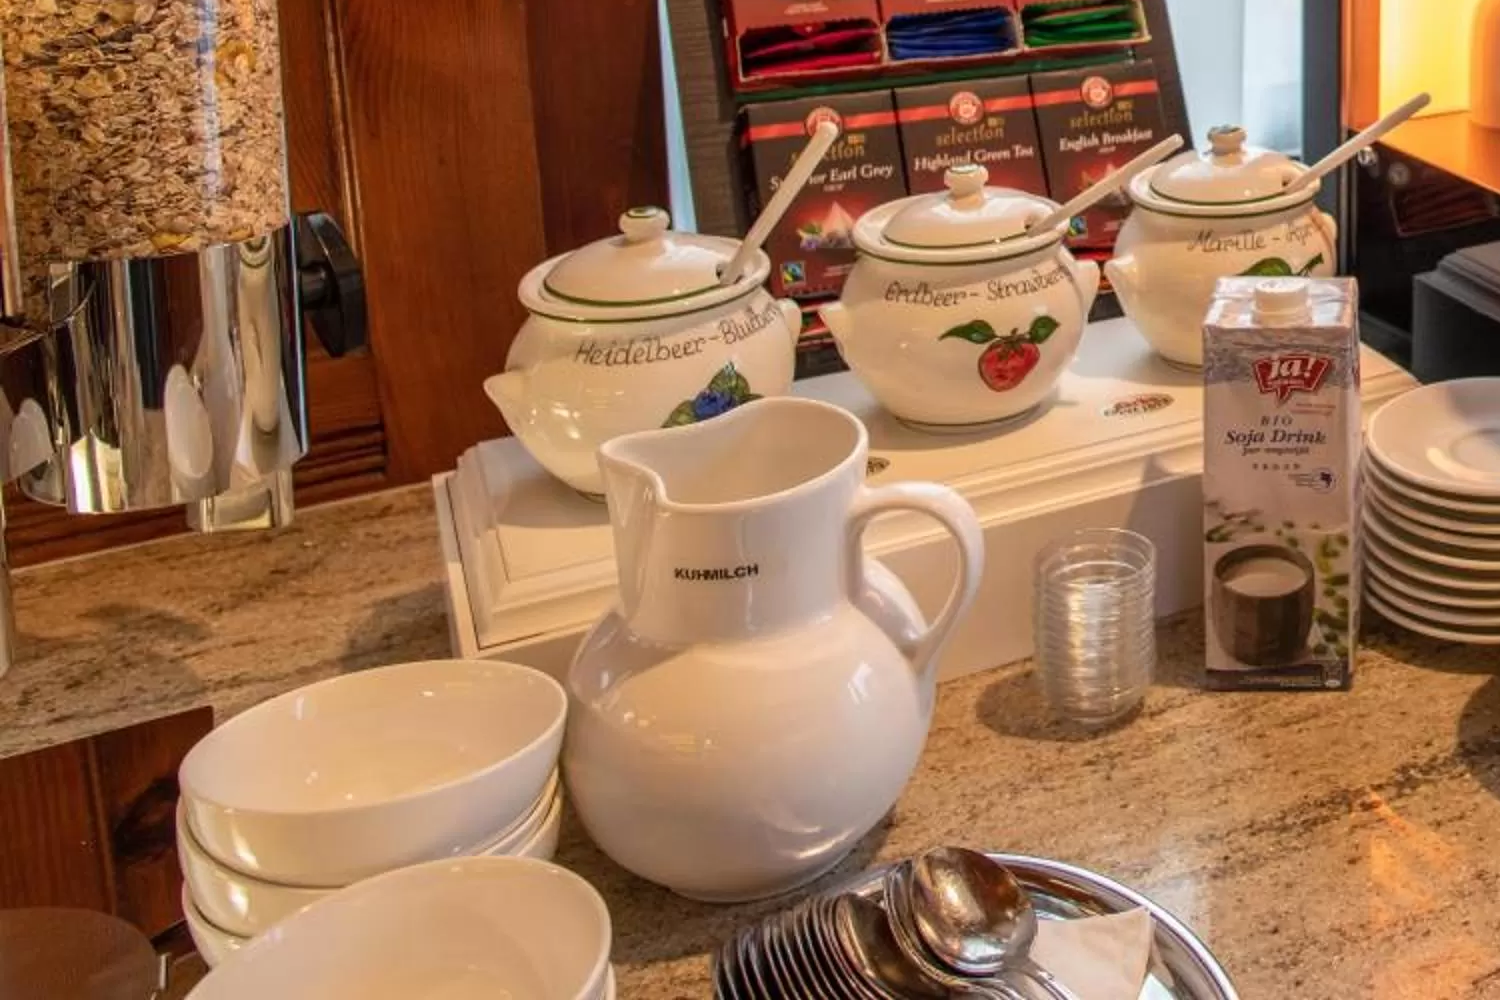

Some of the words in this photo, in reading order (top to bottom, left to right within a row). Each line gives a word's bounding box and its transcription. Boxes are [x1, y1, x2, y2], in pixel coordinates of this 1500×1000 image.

[1069, 107, 1133, 129] selection
[935, 123, 1005, 147] selection
[1059, 132, 1099, 152] English
[1102, 127, 1153, 145] Breakfast
[913, 149, 972, 172] Highland
[974, 148, 1011, 163] Green
[1011, 143, 1034, 159] Tea
[830, 166, 859, 182] Earl
[860, 163, 894, 180] Grey
[1223, 429, 1265, 447] Soja
[1269, 428, 1328, 445] Drink
[673, 563, 759, 581] KUHMILCH
